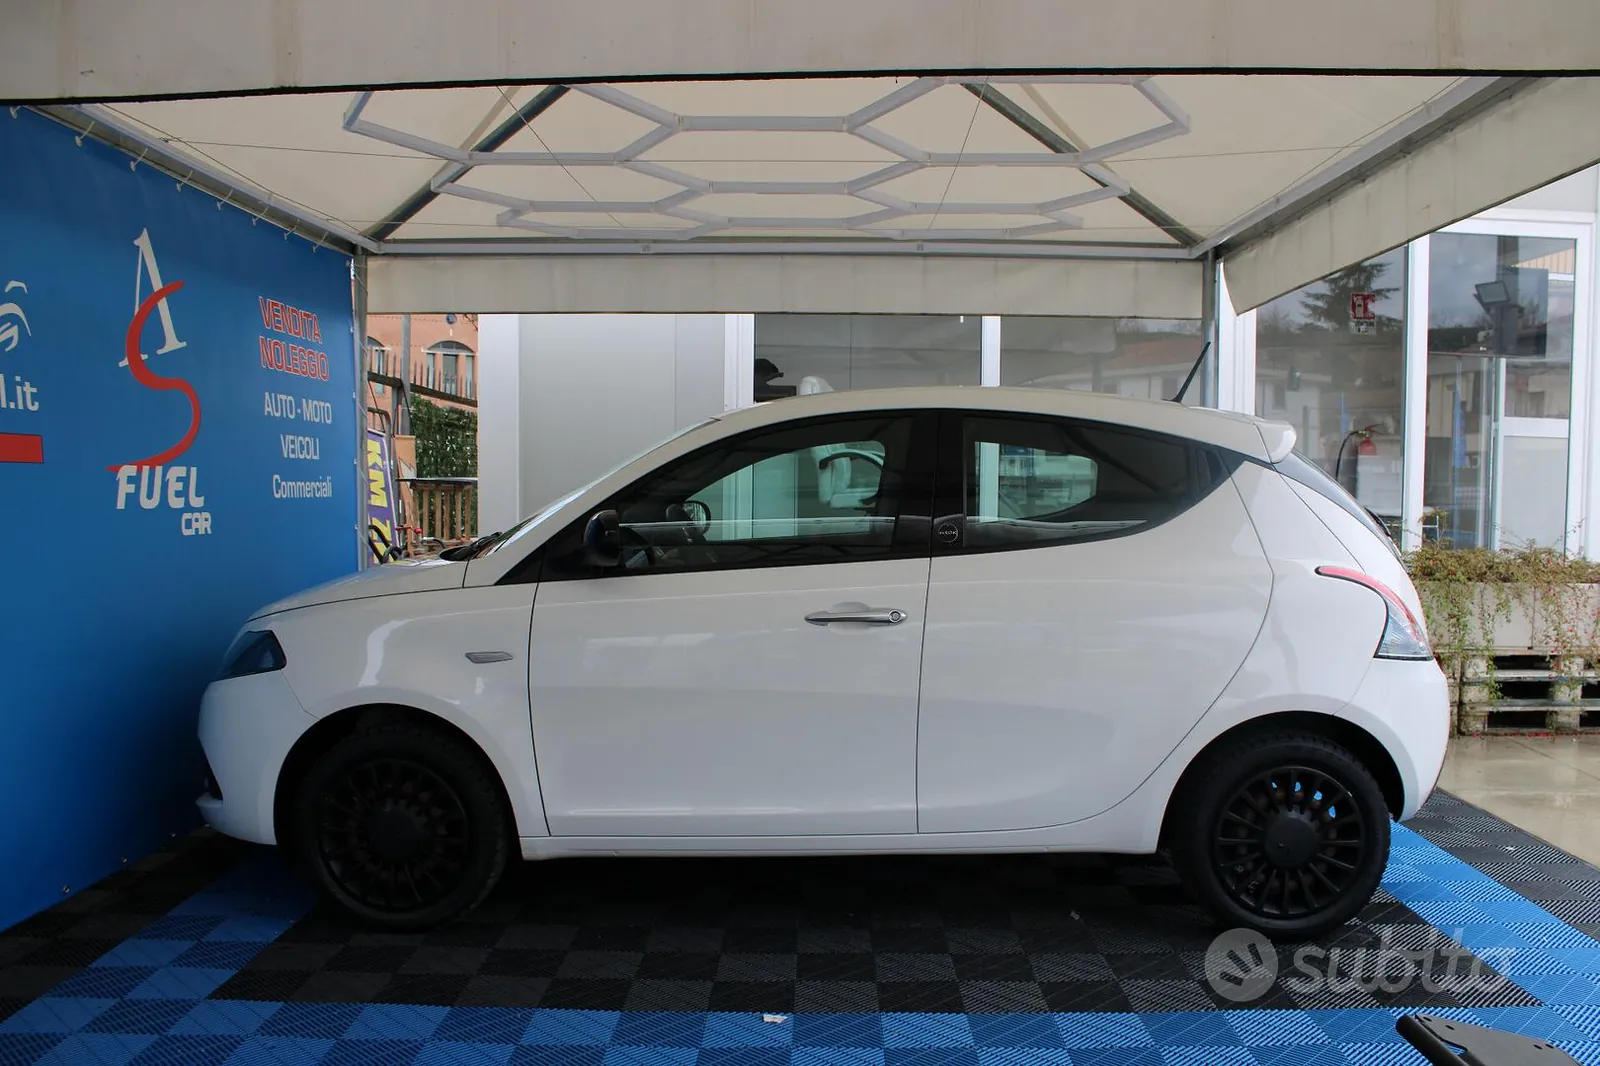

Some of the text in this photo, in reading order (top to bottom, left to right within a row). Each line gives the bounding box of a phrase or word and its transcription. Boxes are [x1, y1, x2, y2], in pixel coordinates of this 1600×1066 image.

[259, 296, 323, 344] VENDITA
[259, 335, 329, 381] NOLEGGIO
[0, 373, 40, 411] .it
[264, 392, 296, 419] AUTO
[302, 398, 332, 424] MOTO
[280, 434, 320, 460] VEICOLI
[116, 464, 205, 509] FUEL
[272, 474, 332, 499] Commerciali
[367, 439, 388, 507] KM
[181, 511, 212, 536] CAR
